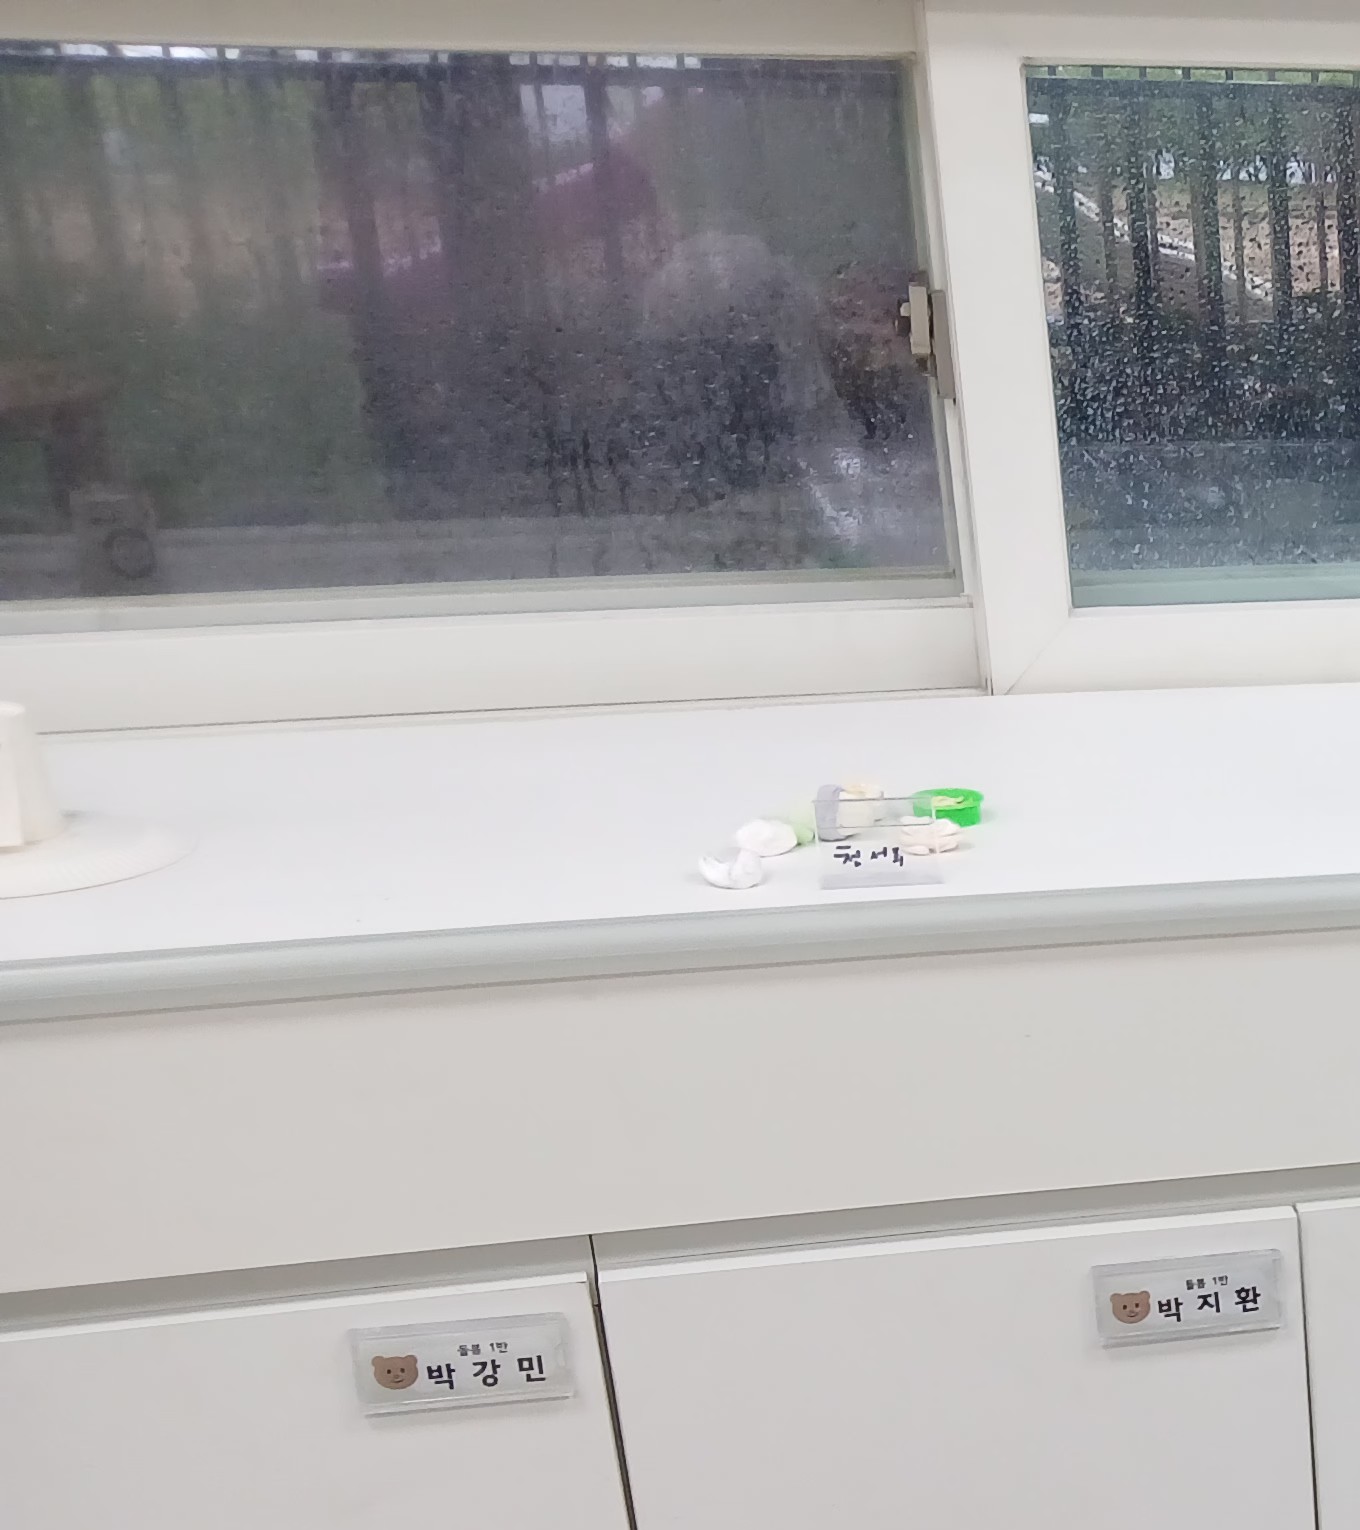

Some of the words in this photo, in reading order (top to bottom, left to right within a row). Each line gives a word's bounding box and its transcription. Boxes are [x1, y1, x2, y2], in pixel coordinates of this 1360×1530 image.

[1157, 1286, 1261, 1323] 박지환
[489, 1341, 508, 1354] 1반
[426, 1355, 547, 1390] 박강민
